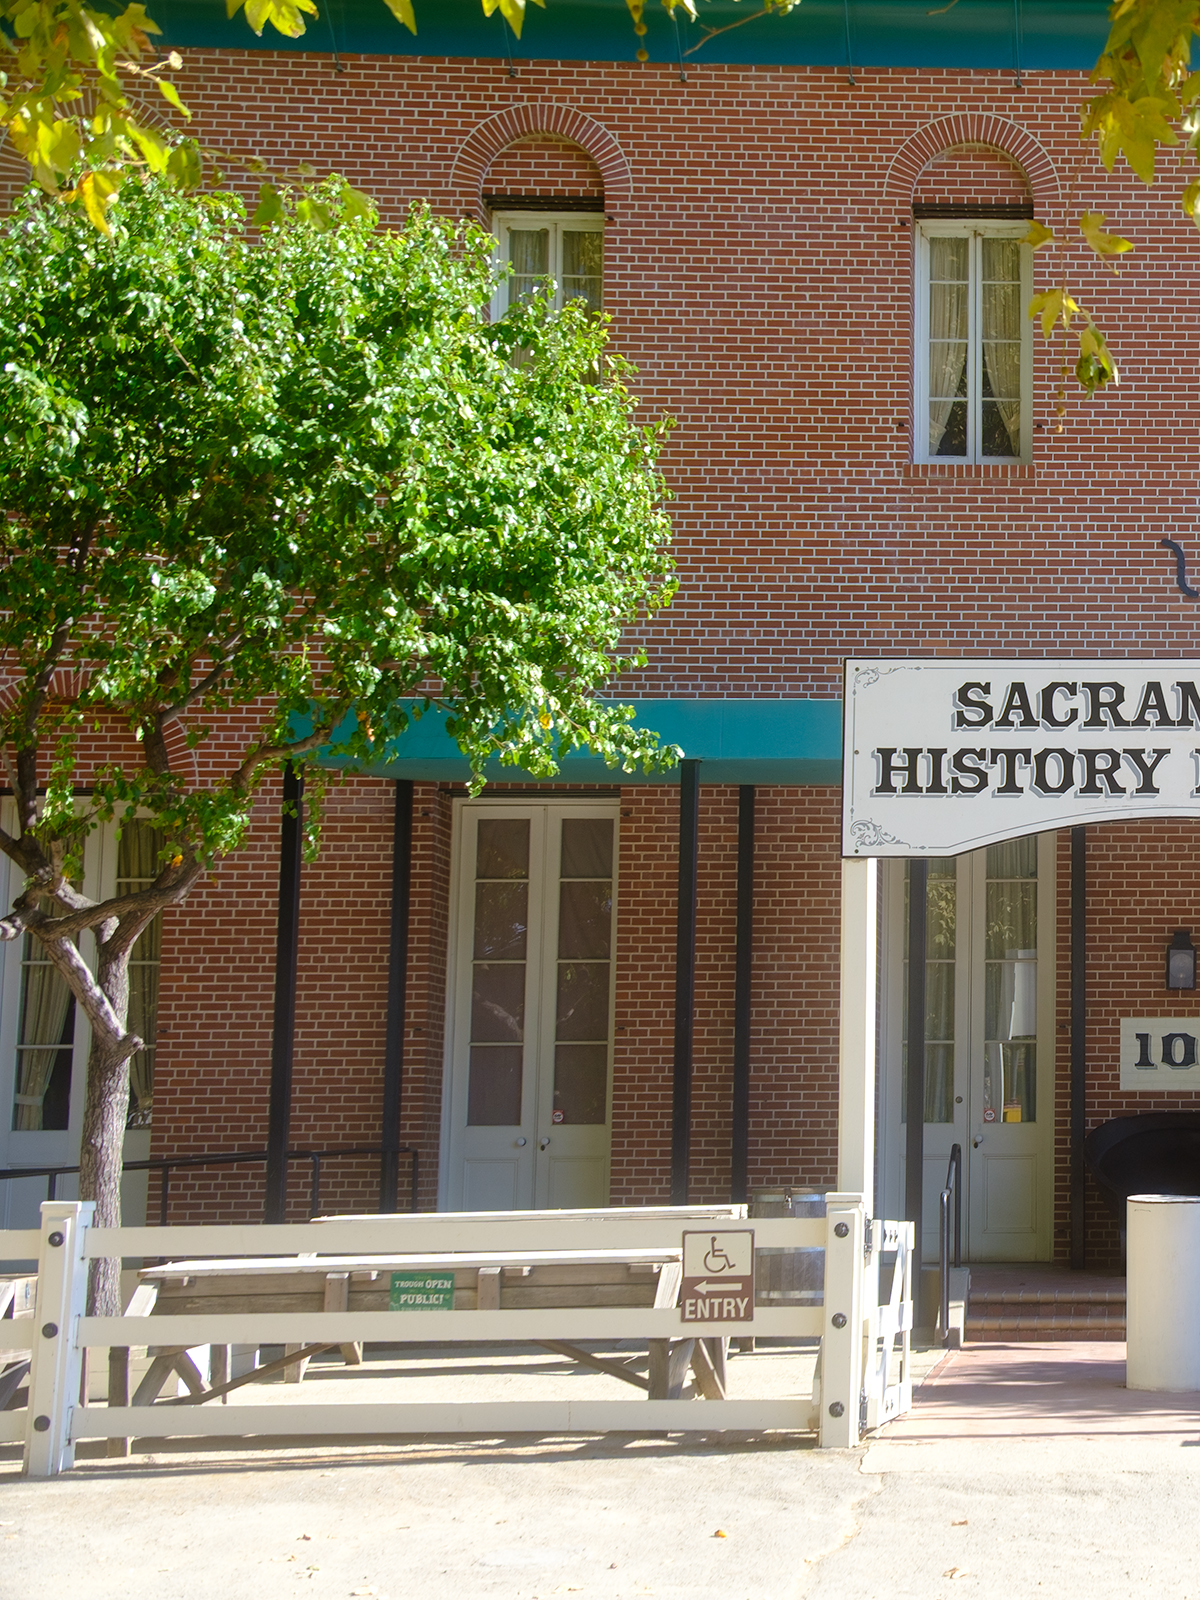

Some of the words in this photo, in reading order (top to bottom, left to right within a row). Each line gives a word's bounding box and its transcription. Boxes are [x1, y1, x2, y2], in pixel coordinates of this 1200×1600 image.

[869, 748, 1171, 799] HISTORY
[394, 1280, 425, 1288] TROUGH
[425, 1279, 453, 1289] OPEN
[399, 1293, 445, 1305] PUBLIC!
[685, 1297, 750, 1319] ENTRY
